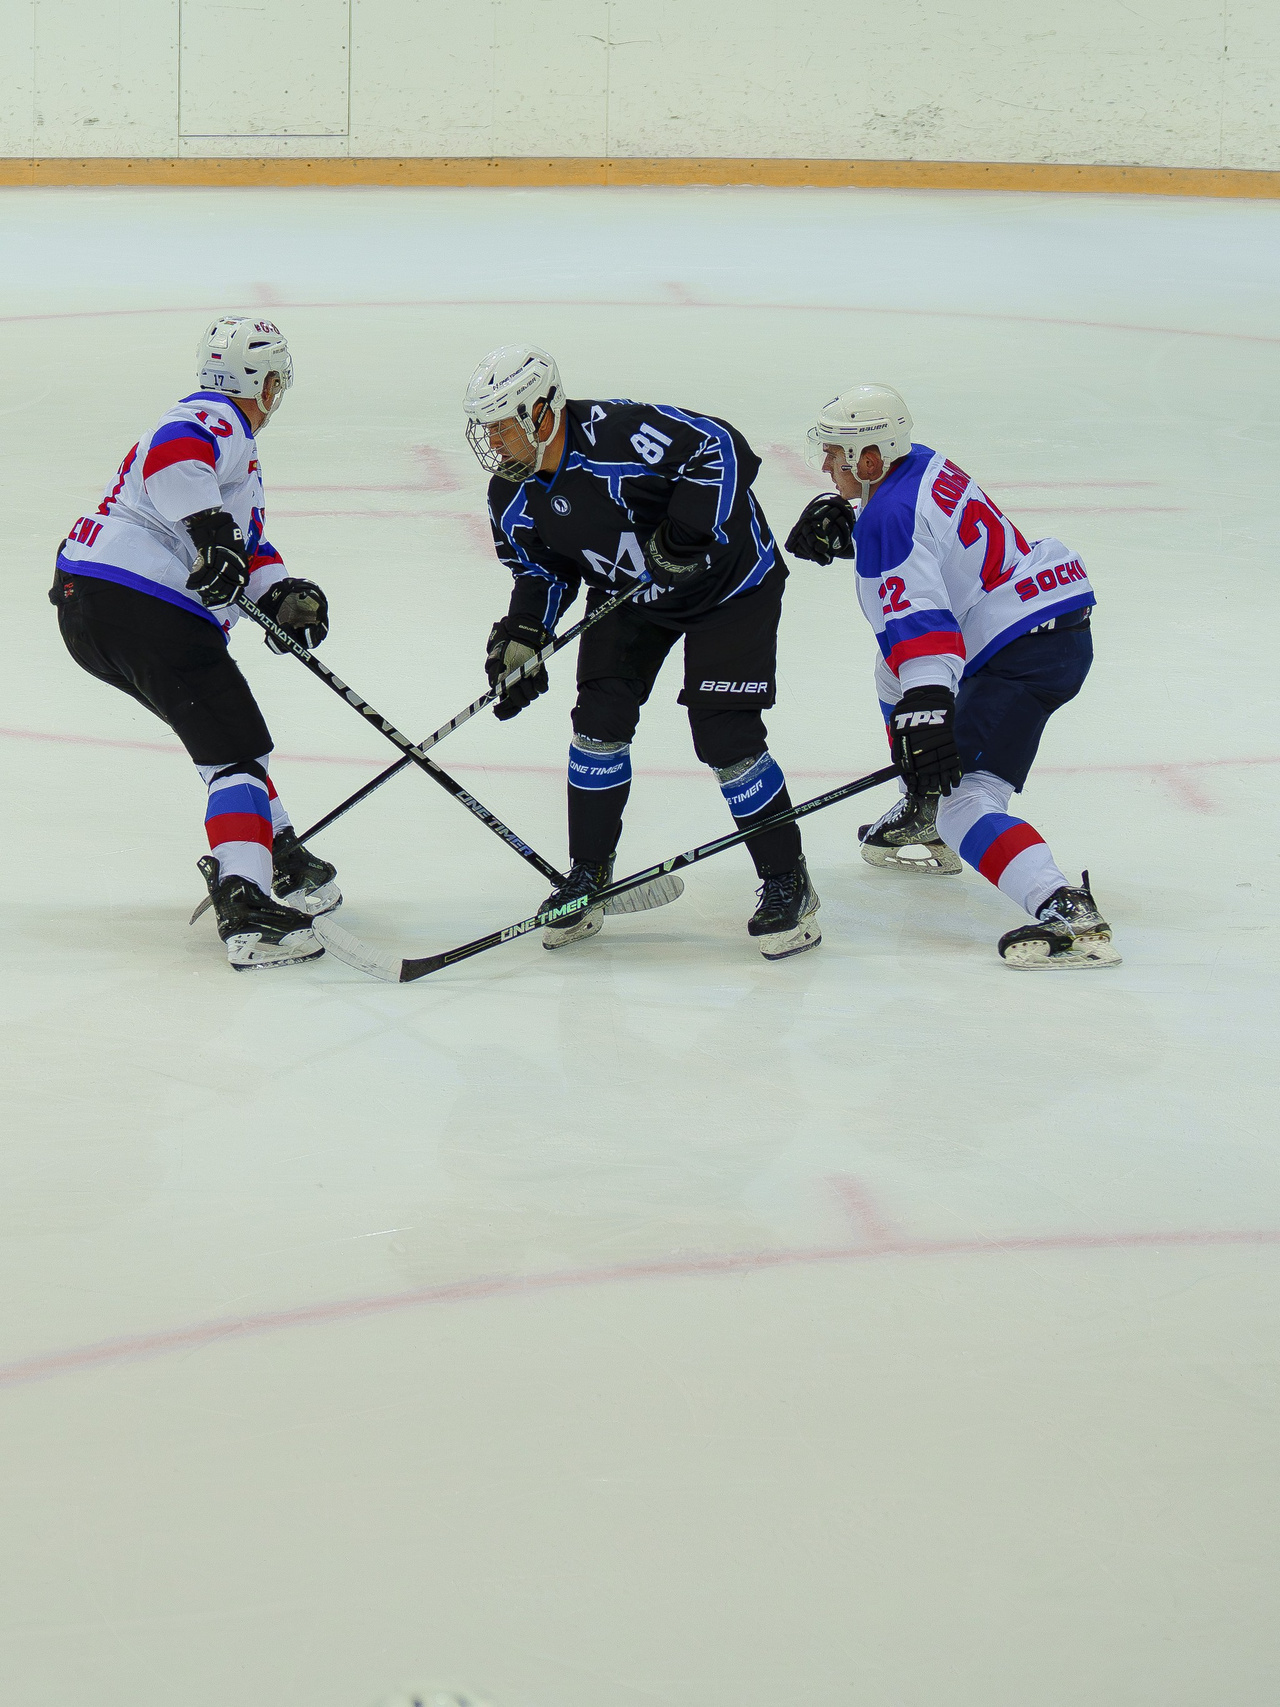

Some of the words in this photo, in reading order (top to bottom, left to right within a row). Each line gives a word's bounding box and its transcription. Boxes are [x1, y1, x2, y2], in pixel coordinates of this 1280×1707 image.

[213, 374, 224, 386] 17
[630, 421, 673, 464] 81
[859, 423, 888, 433] BAUER
[68, 516, 104, 548] CHI
[648, 536, 699, 574] AUER
[1014, 559, 1088, 603] SOCHI
[239, 594, 312, 662] DOMINATOR
[699, 680, 768, 694] BAUER
[894, 709, 948, 730] TPS
[569, 760, 590, 774] ONE
[590, 762, 624, 776] TIMER
[731, 778, 764, 804] TIMER
[794, 799, 822, 815] FIRE
[456, 789, 492, 820] ONE
[488, 816, 534, 857] TIMER
[500, 917, 536, 941] ONE
[538, 894, 589, 925] TIMER
